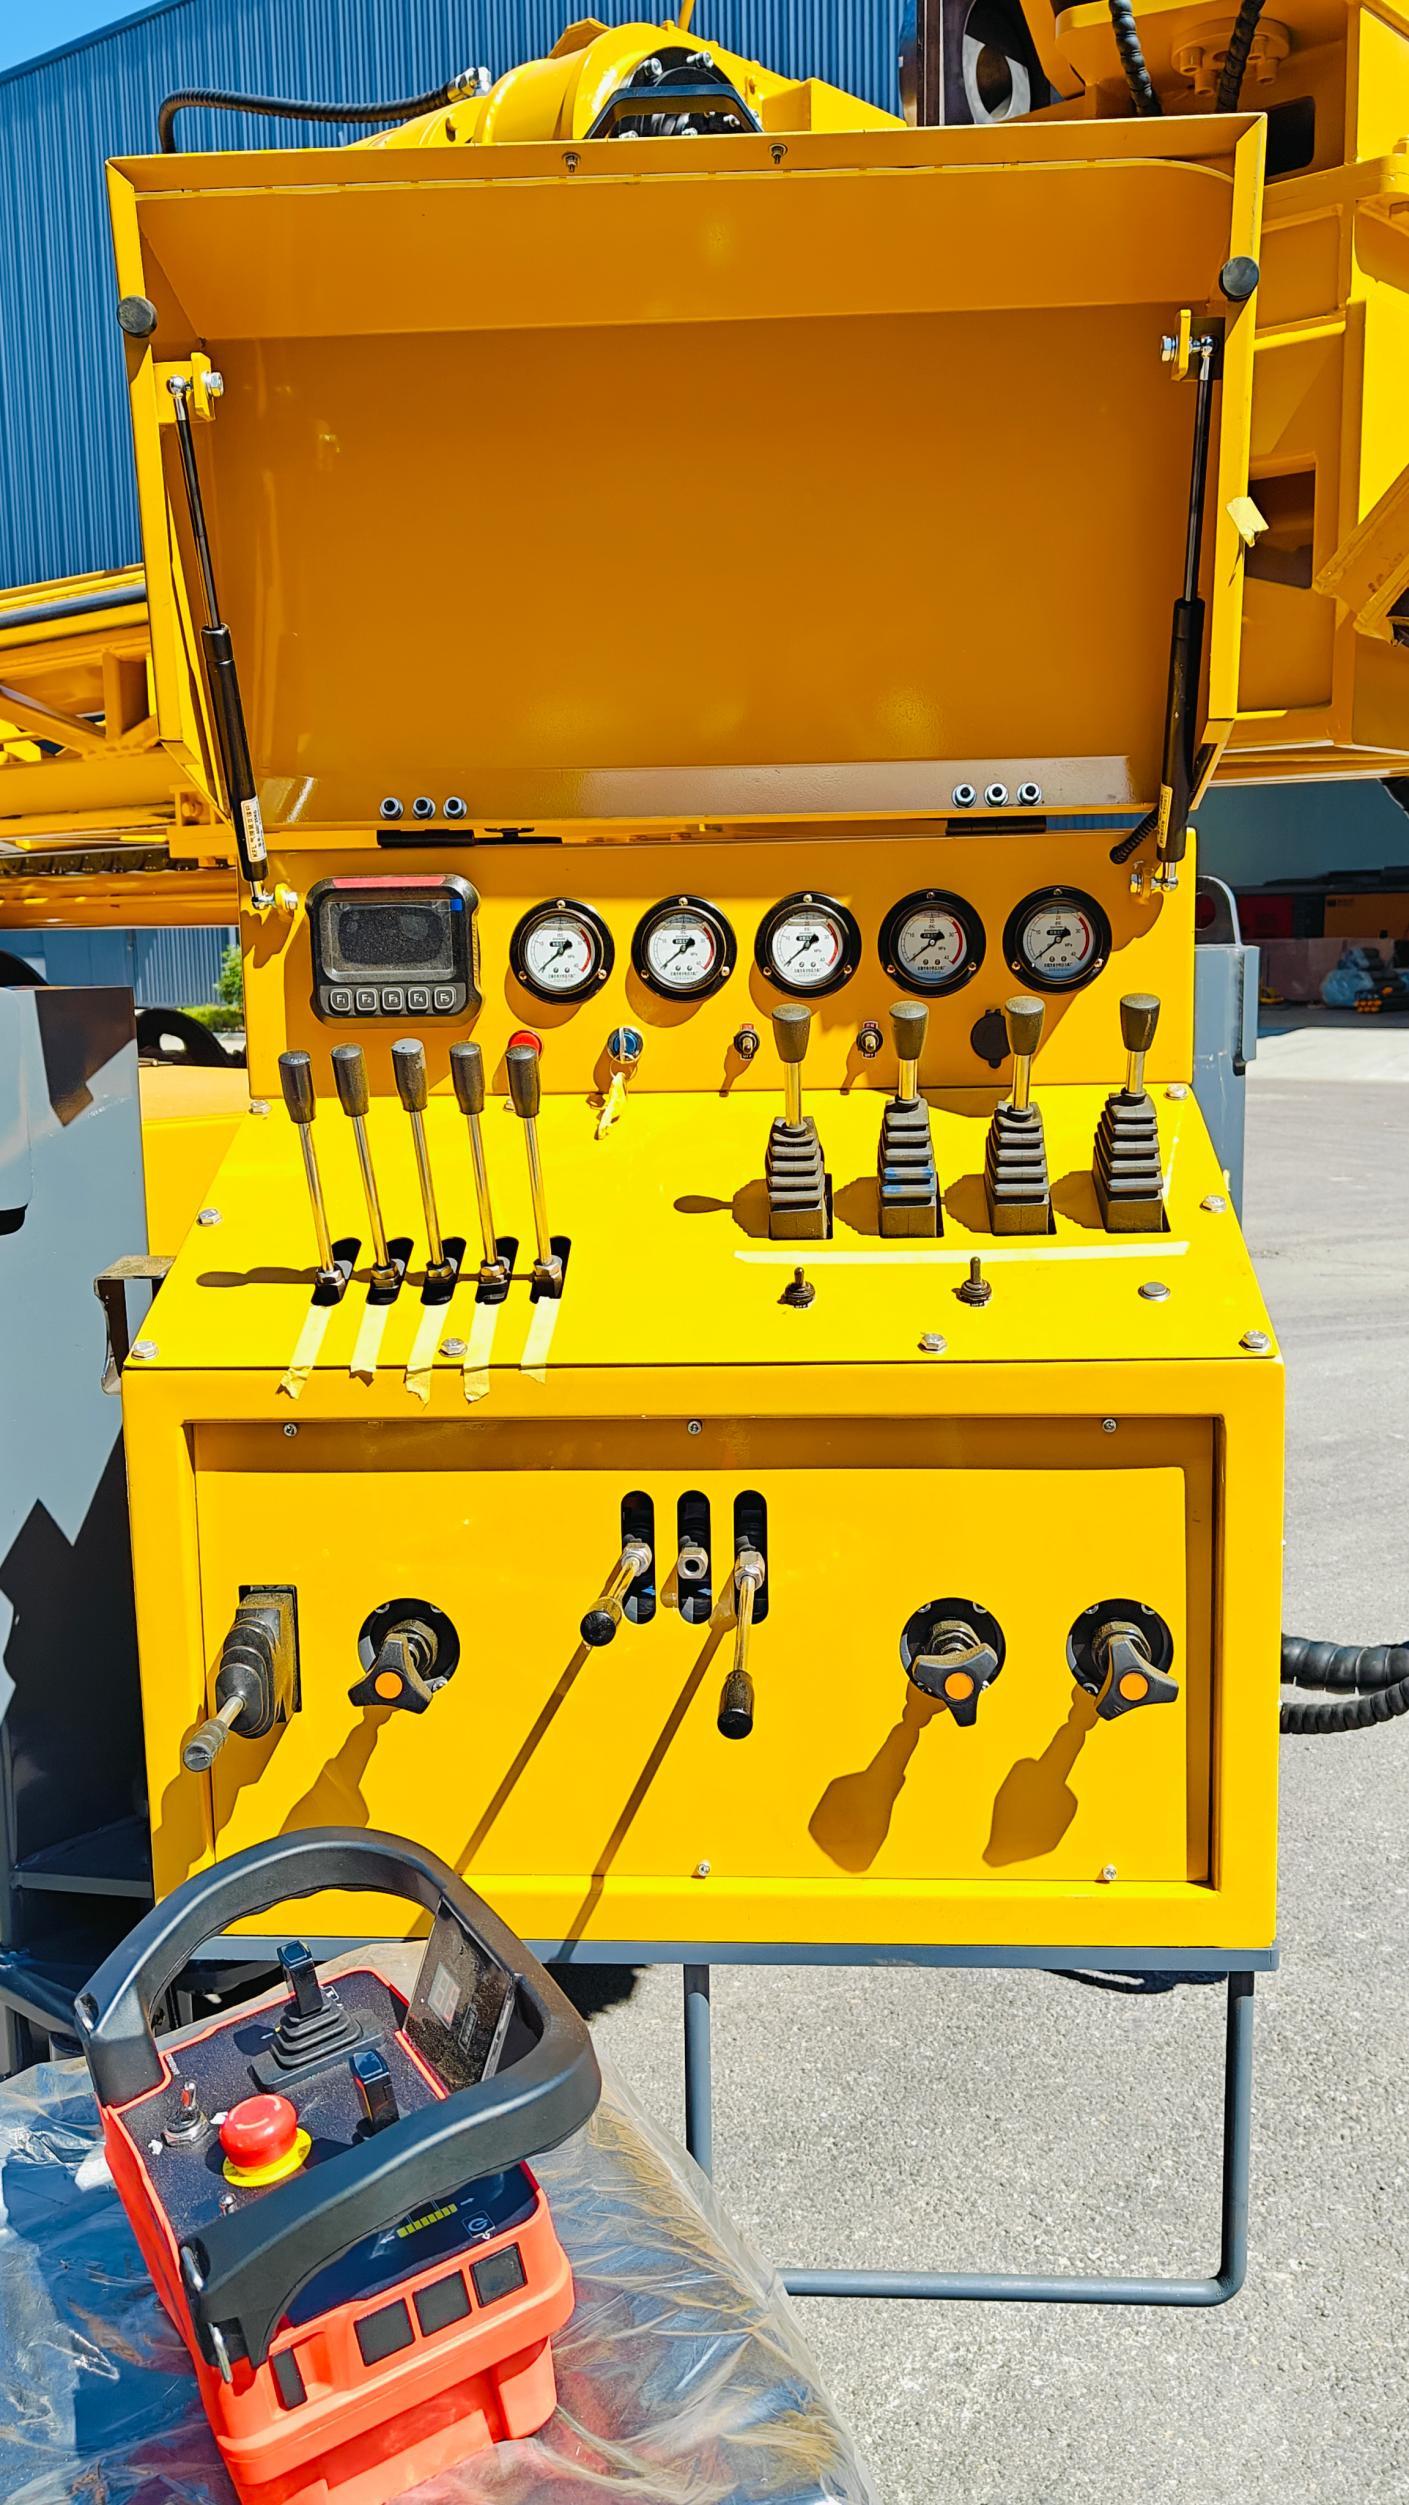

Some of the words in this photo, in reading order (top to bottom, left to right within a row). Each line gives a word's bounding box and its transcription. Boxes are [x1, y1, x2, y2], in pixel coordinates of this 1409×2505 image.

[336, 994, 346, 1004] F1
[361, 993, 372, 1004] F2
[388, 993, 398, 1003] F3
[413, 993, 423, 1003] F4
[440, 993, 450, 1003] F5
